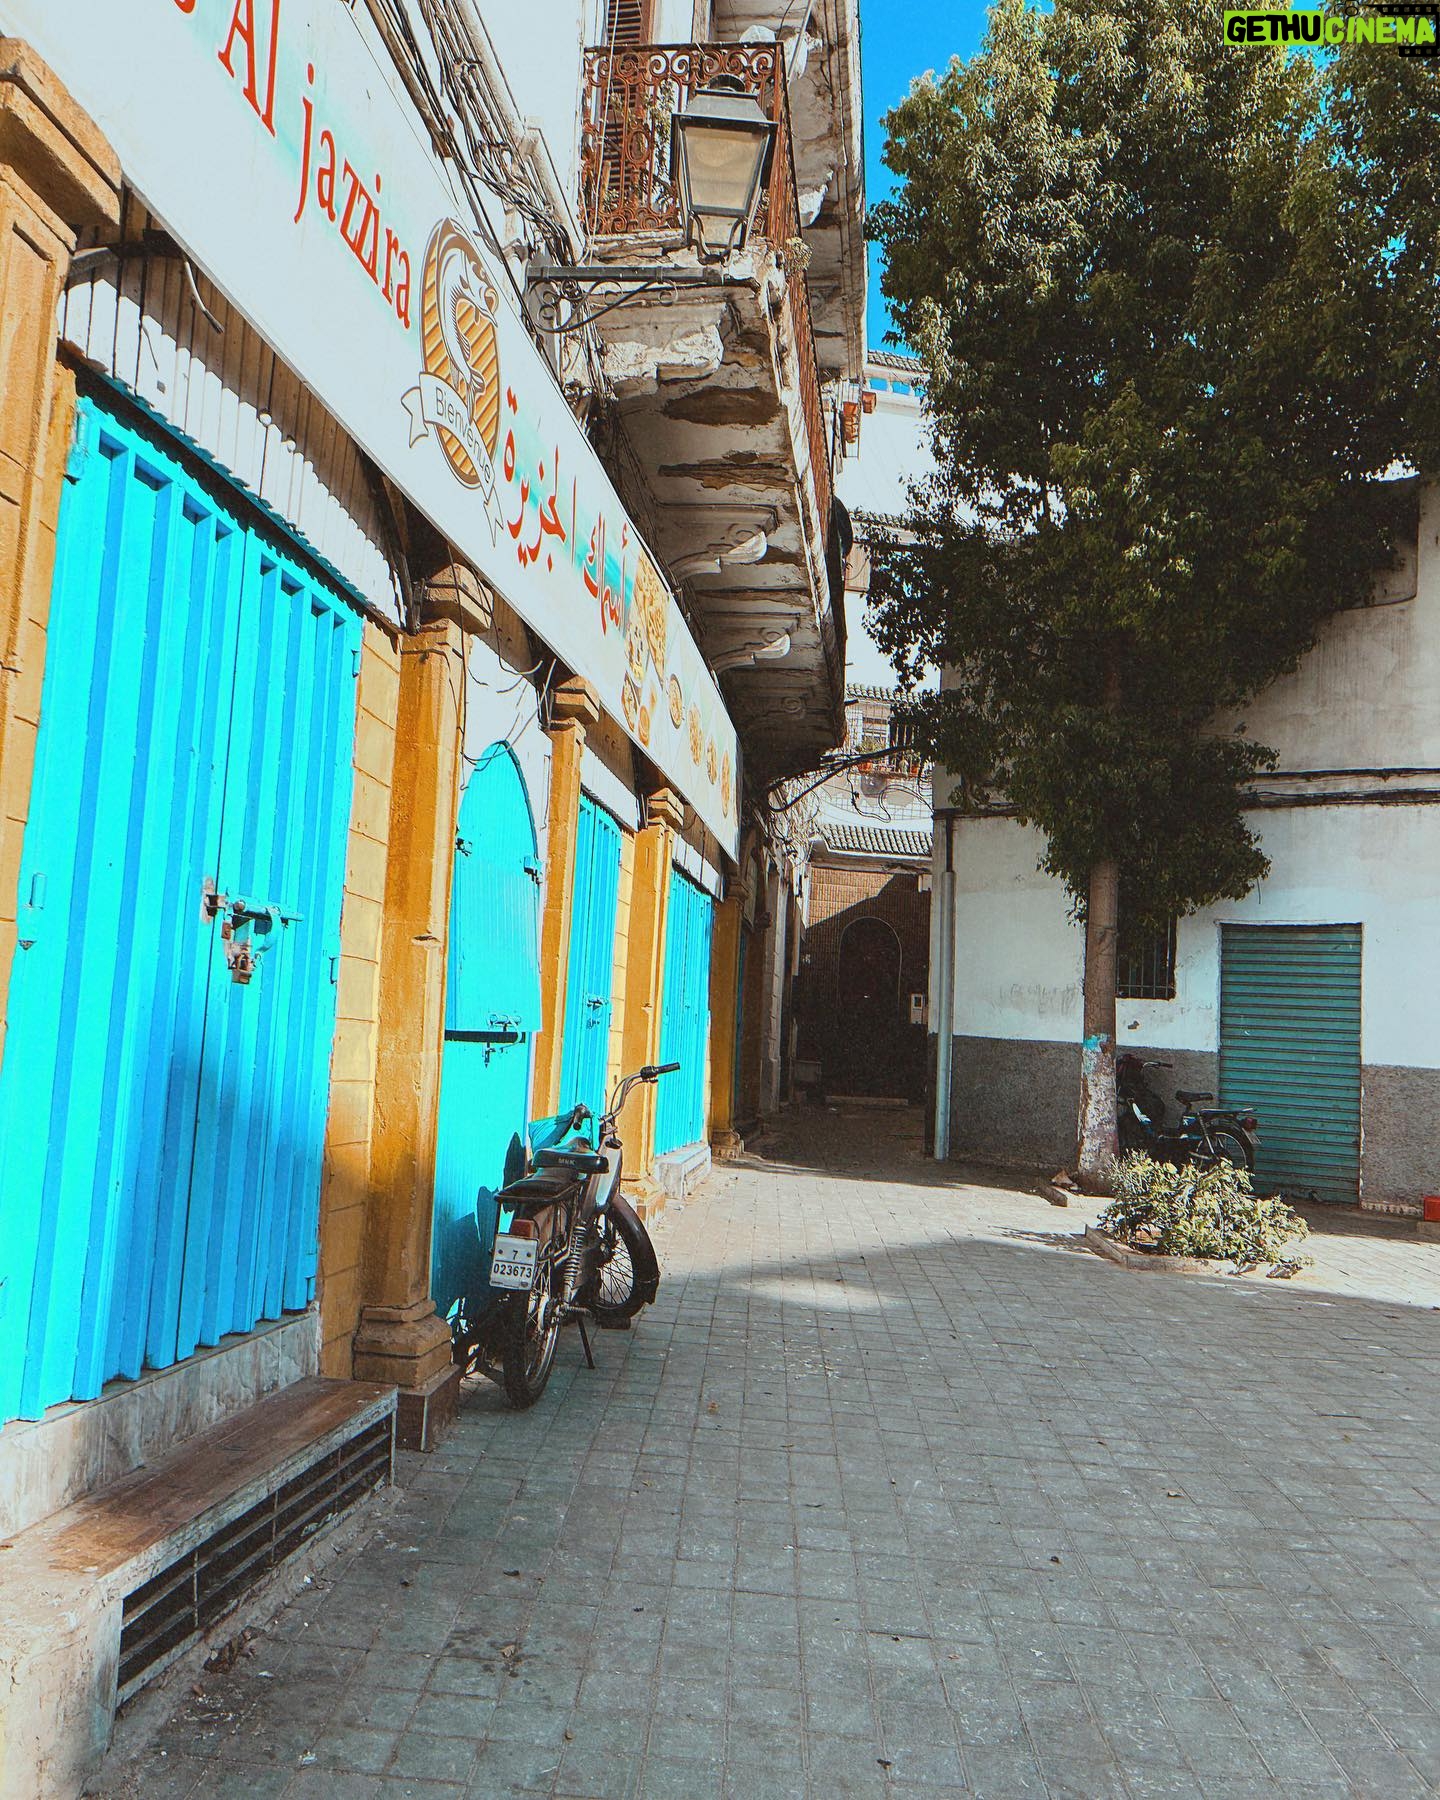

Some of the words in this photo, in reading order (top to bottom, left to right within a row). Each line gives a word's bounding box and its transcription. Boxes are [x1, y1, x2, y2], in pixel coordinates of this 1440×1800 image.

[218, 0, 280, 137] Al
[294, 62, 412, 330] jazzira
[435, 386, 491, 484] Bienvenue
[504, 385, 577, 573] الجزيرة
[493, 1263, 533, 1279] 023673
[512, 1249, 519, 1261] 7
